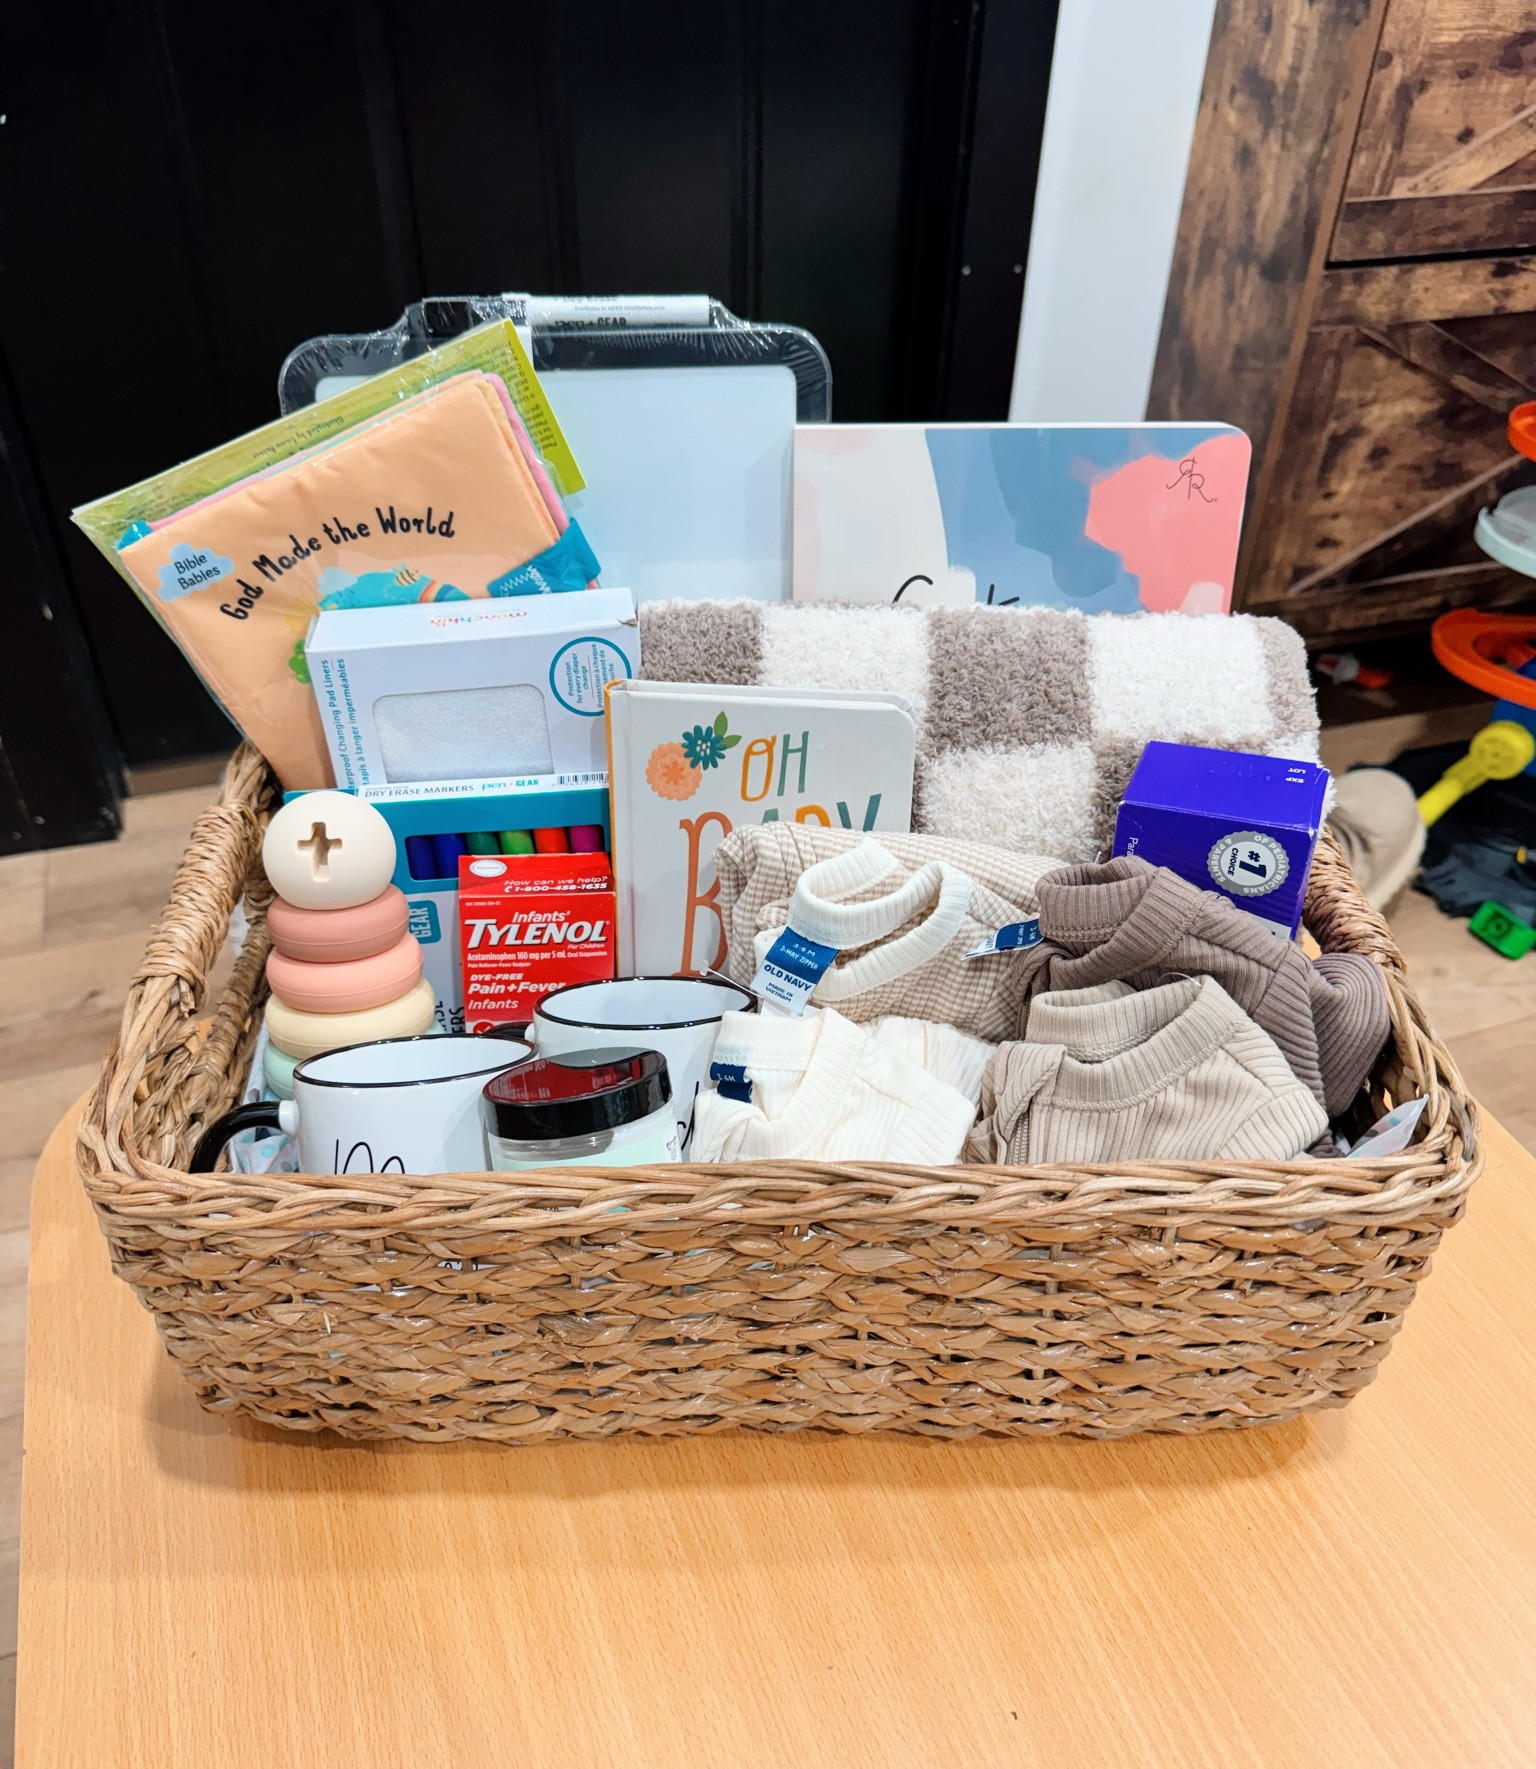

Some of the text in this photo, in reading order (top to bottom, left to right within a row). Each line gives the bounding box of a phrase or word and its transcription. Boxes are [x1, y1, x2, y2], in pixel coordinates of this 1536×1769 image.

[219, 505, 456, 621] God Made the World
[572, 653, 580, 675] diaper
[591, 643, 600, 669] chaque
[599, 649, 605, 659] de
[565, 661, 574, 696] Protection
[581, 665, 589, 690] change
[608, 662, 616, 681] uche
[337, 658, 357, 725] imperméables
[594, 675, 604, 708] Protection
[321, 659, 356, 789] terproof Changing Pad Liners
[351, 726, 364, 755] langer
[358, 763, 370, 786] tapis
[740, 730, 810, 802] OH
[365, 790, 387, 798] DRY
[389, 788, 420, 797] ERASE
[424, 784, 475, 795] MARKERS
[515, 779, 540, 787] GEAR
[1210, 843, 1226, 883] PARENTS
[1227, 847, 1239, 876] CHOICE
[1238, 850, 1267, 878] #1
[1243, 835, 1286, 894] OF PEDIATRICIANS
[504, 879, 531, 887] How
[576, 875, 608, 885] help?
[514, 883, 608, 892] 1-800-458-1635
[409, 906, 433, 938] GEAR
[463, 919, 608, 950] TYLENOL
[467, 951, 517, 962] Acetaminophen
[517, 951, 529, 960] 160
[529, 953, 540, 961] mg
[540, 951, 552, 961] per
[552, 950, 557, 958] 5
[578, 950, 608, 958] Suspension
[780, 945, 819, 971] 2-WAY ZIPPER
[470, 972, 524, 982] DYE-FREE
[764, 964, 812, 992] OLD NAVY
[768, 982, 786, 993] MADE
[468, 999, 519, 1010] Infants
[765, 986, 792, 1003] VIETNAM
